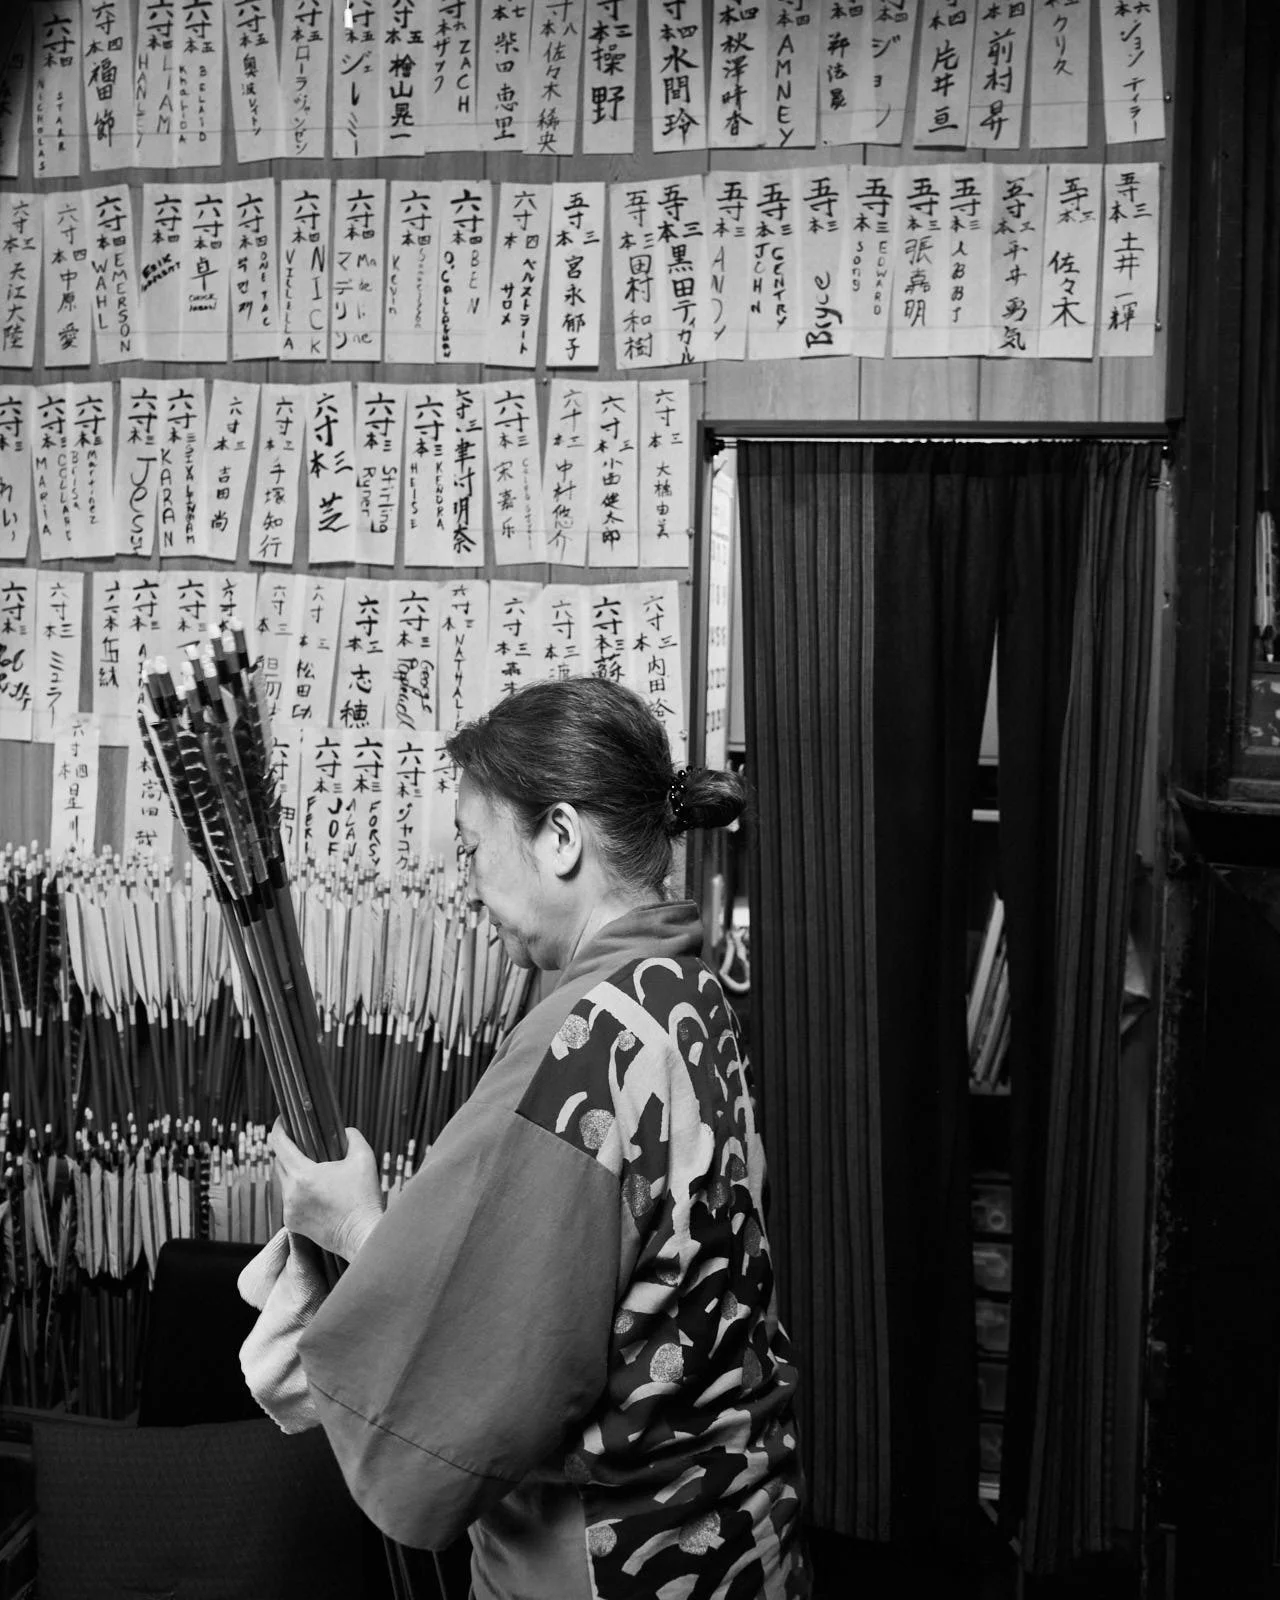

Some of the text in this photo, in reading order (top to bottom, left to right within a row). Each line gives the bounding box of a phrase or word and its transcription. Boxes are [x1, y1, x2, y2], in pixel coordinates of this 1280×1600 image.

[456, 39, 471, 113] ZACH
[91, 259, 108, 331] WAHL
[112, 253, 130, 352] EMERSON
[310, 245, 325, 353] NICK
[874, 240, 887, 315] EDWARD
[1048, 251, 1086, 328] 佐々木
[34, 457, 51, 537] MARIA
[158, 448, 175, 549] KARAN
